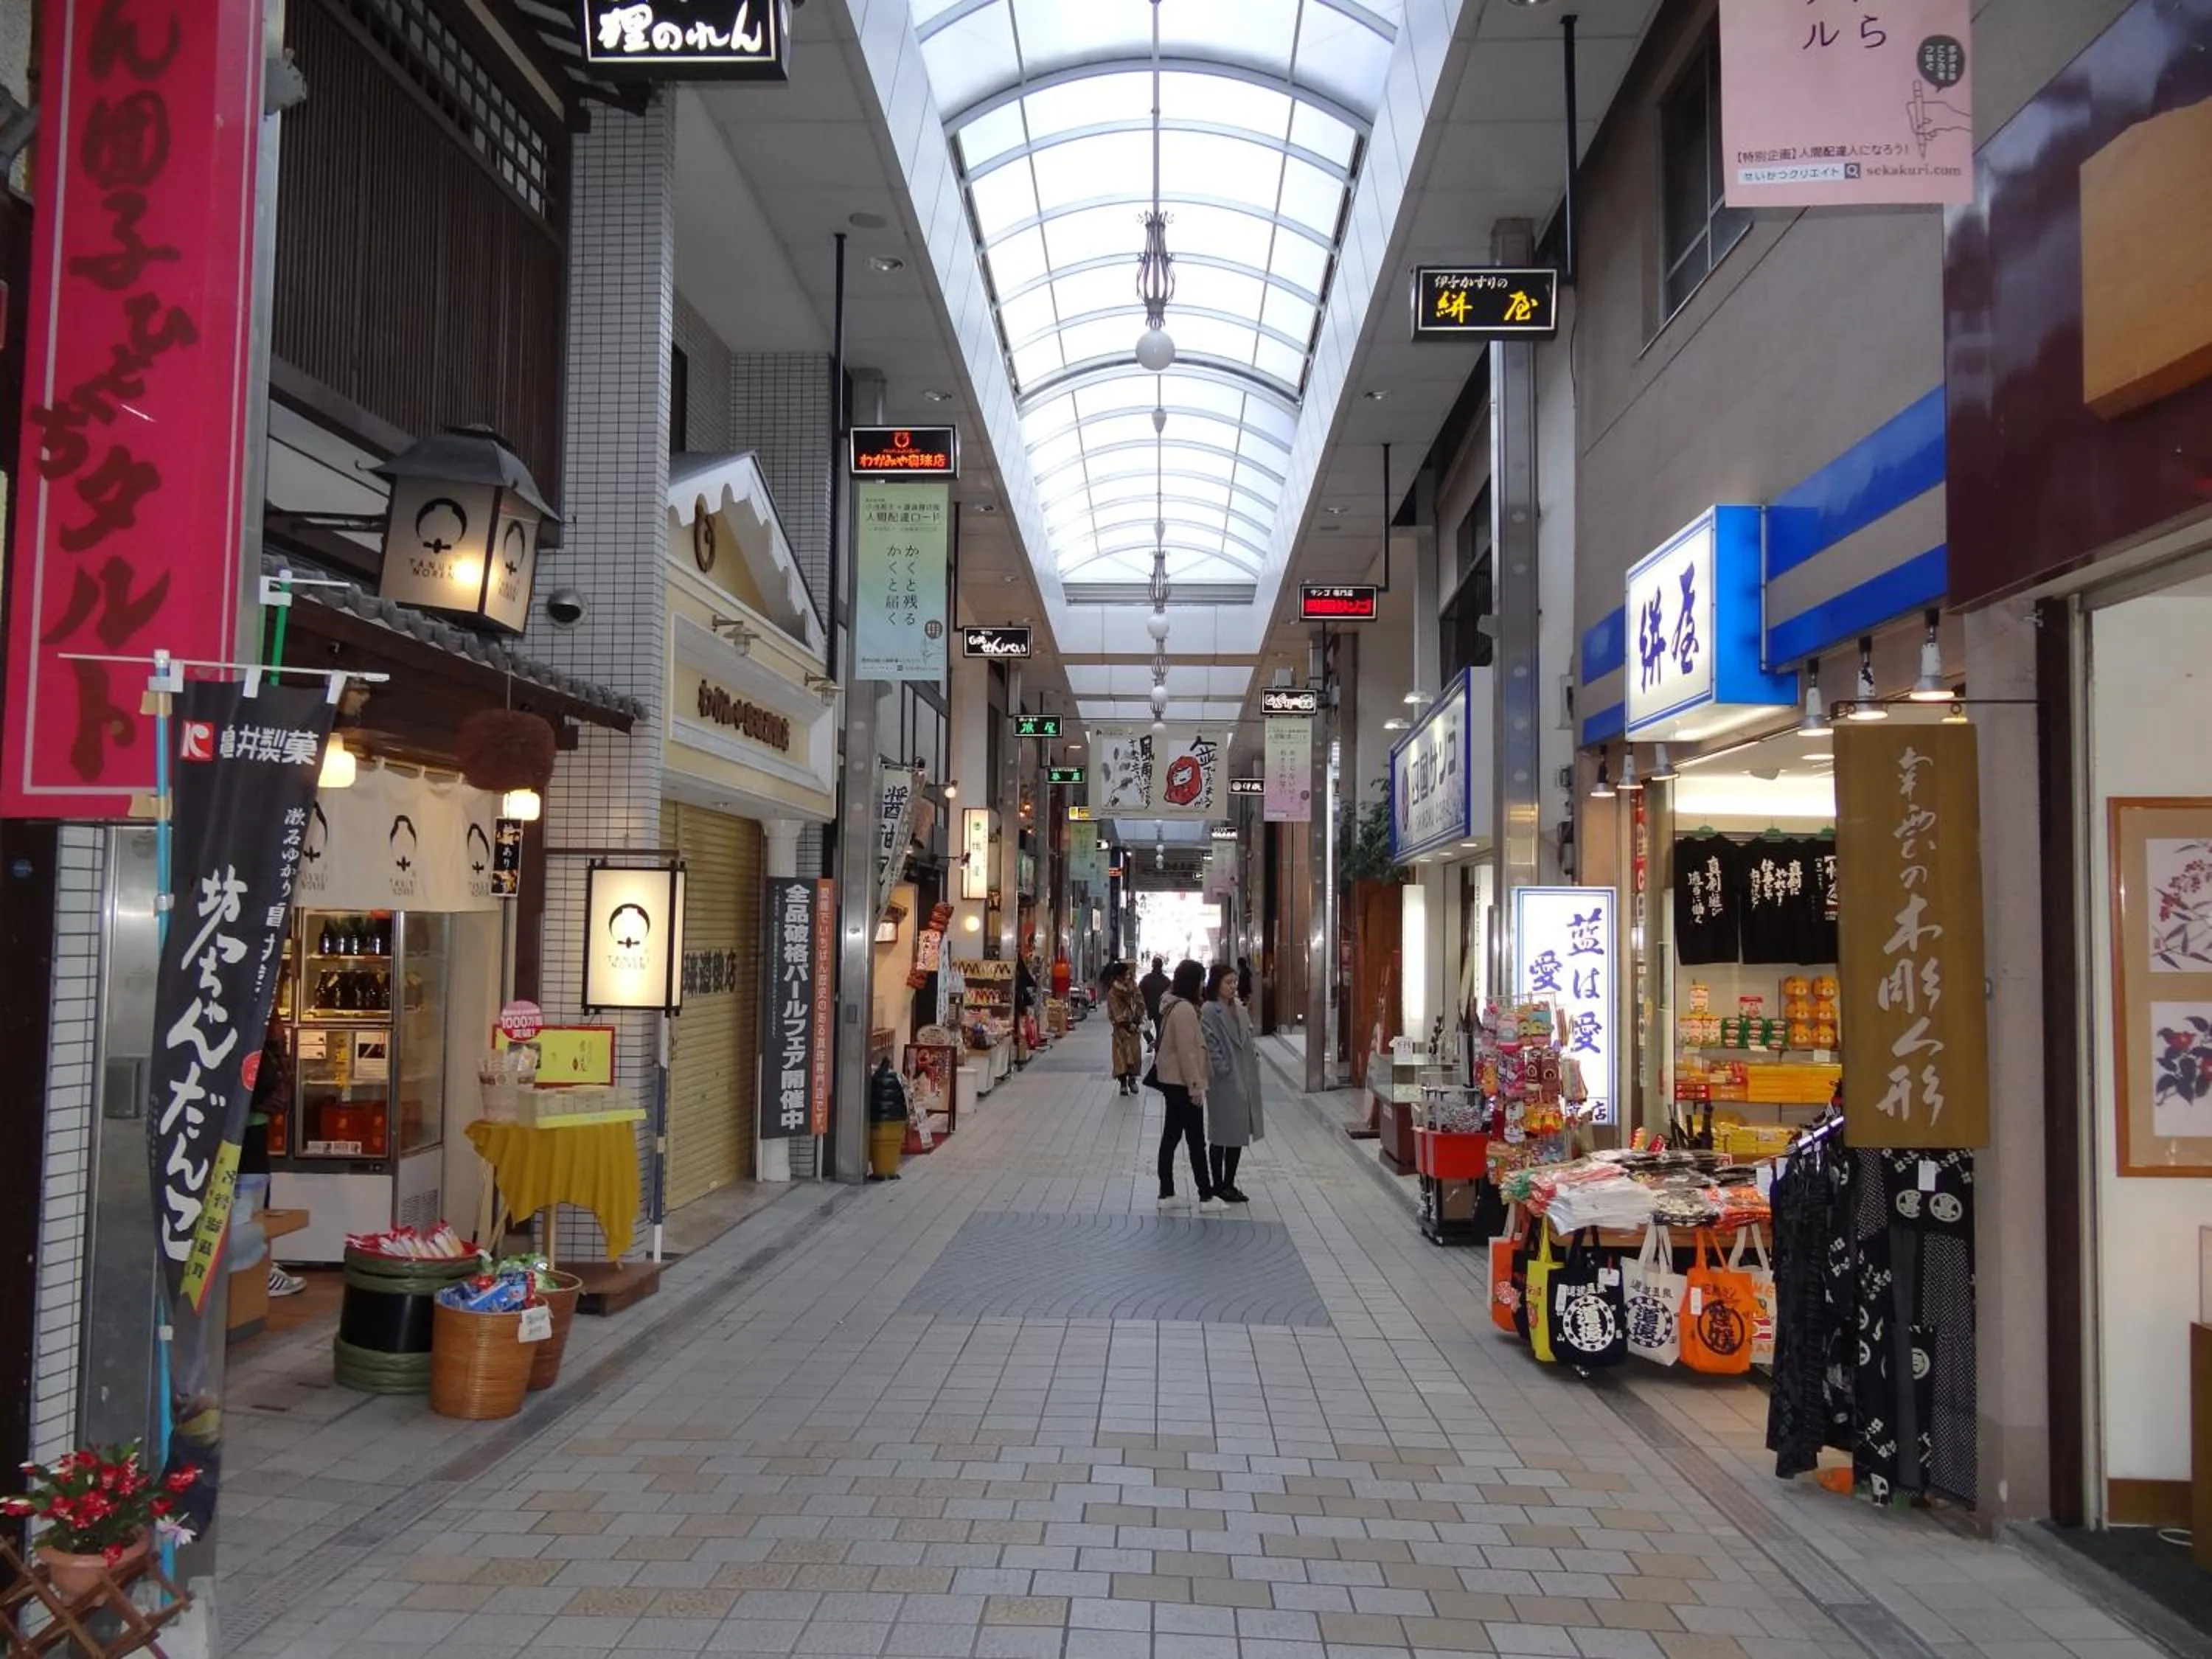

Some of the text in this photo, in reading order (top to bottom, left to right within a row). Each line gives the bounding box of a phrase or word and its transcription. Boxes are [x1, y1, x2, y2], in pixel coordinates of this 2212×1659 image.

[902, 543, 920, 626] かくと残る
[779, 884, 810, 1130] 全品破格パールフェア開催中
